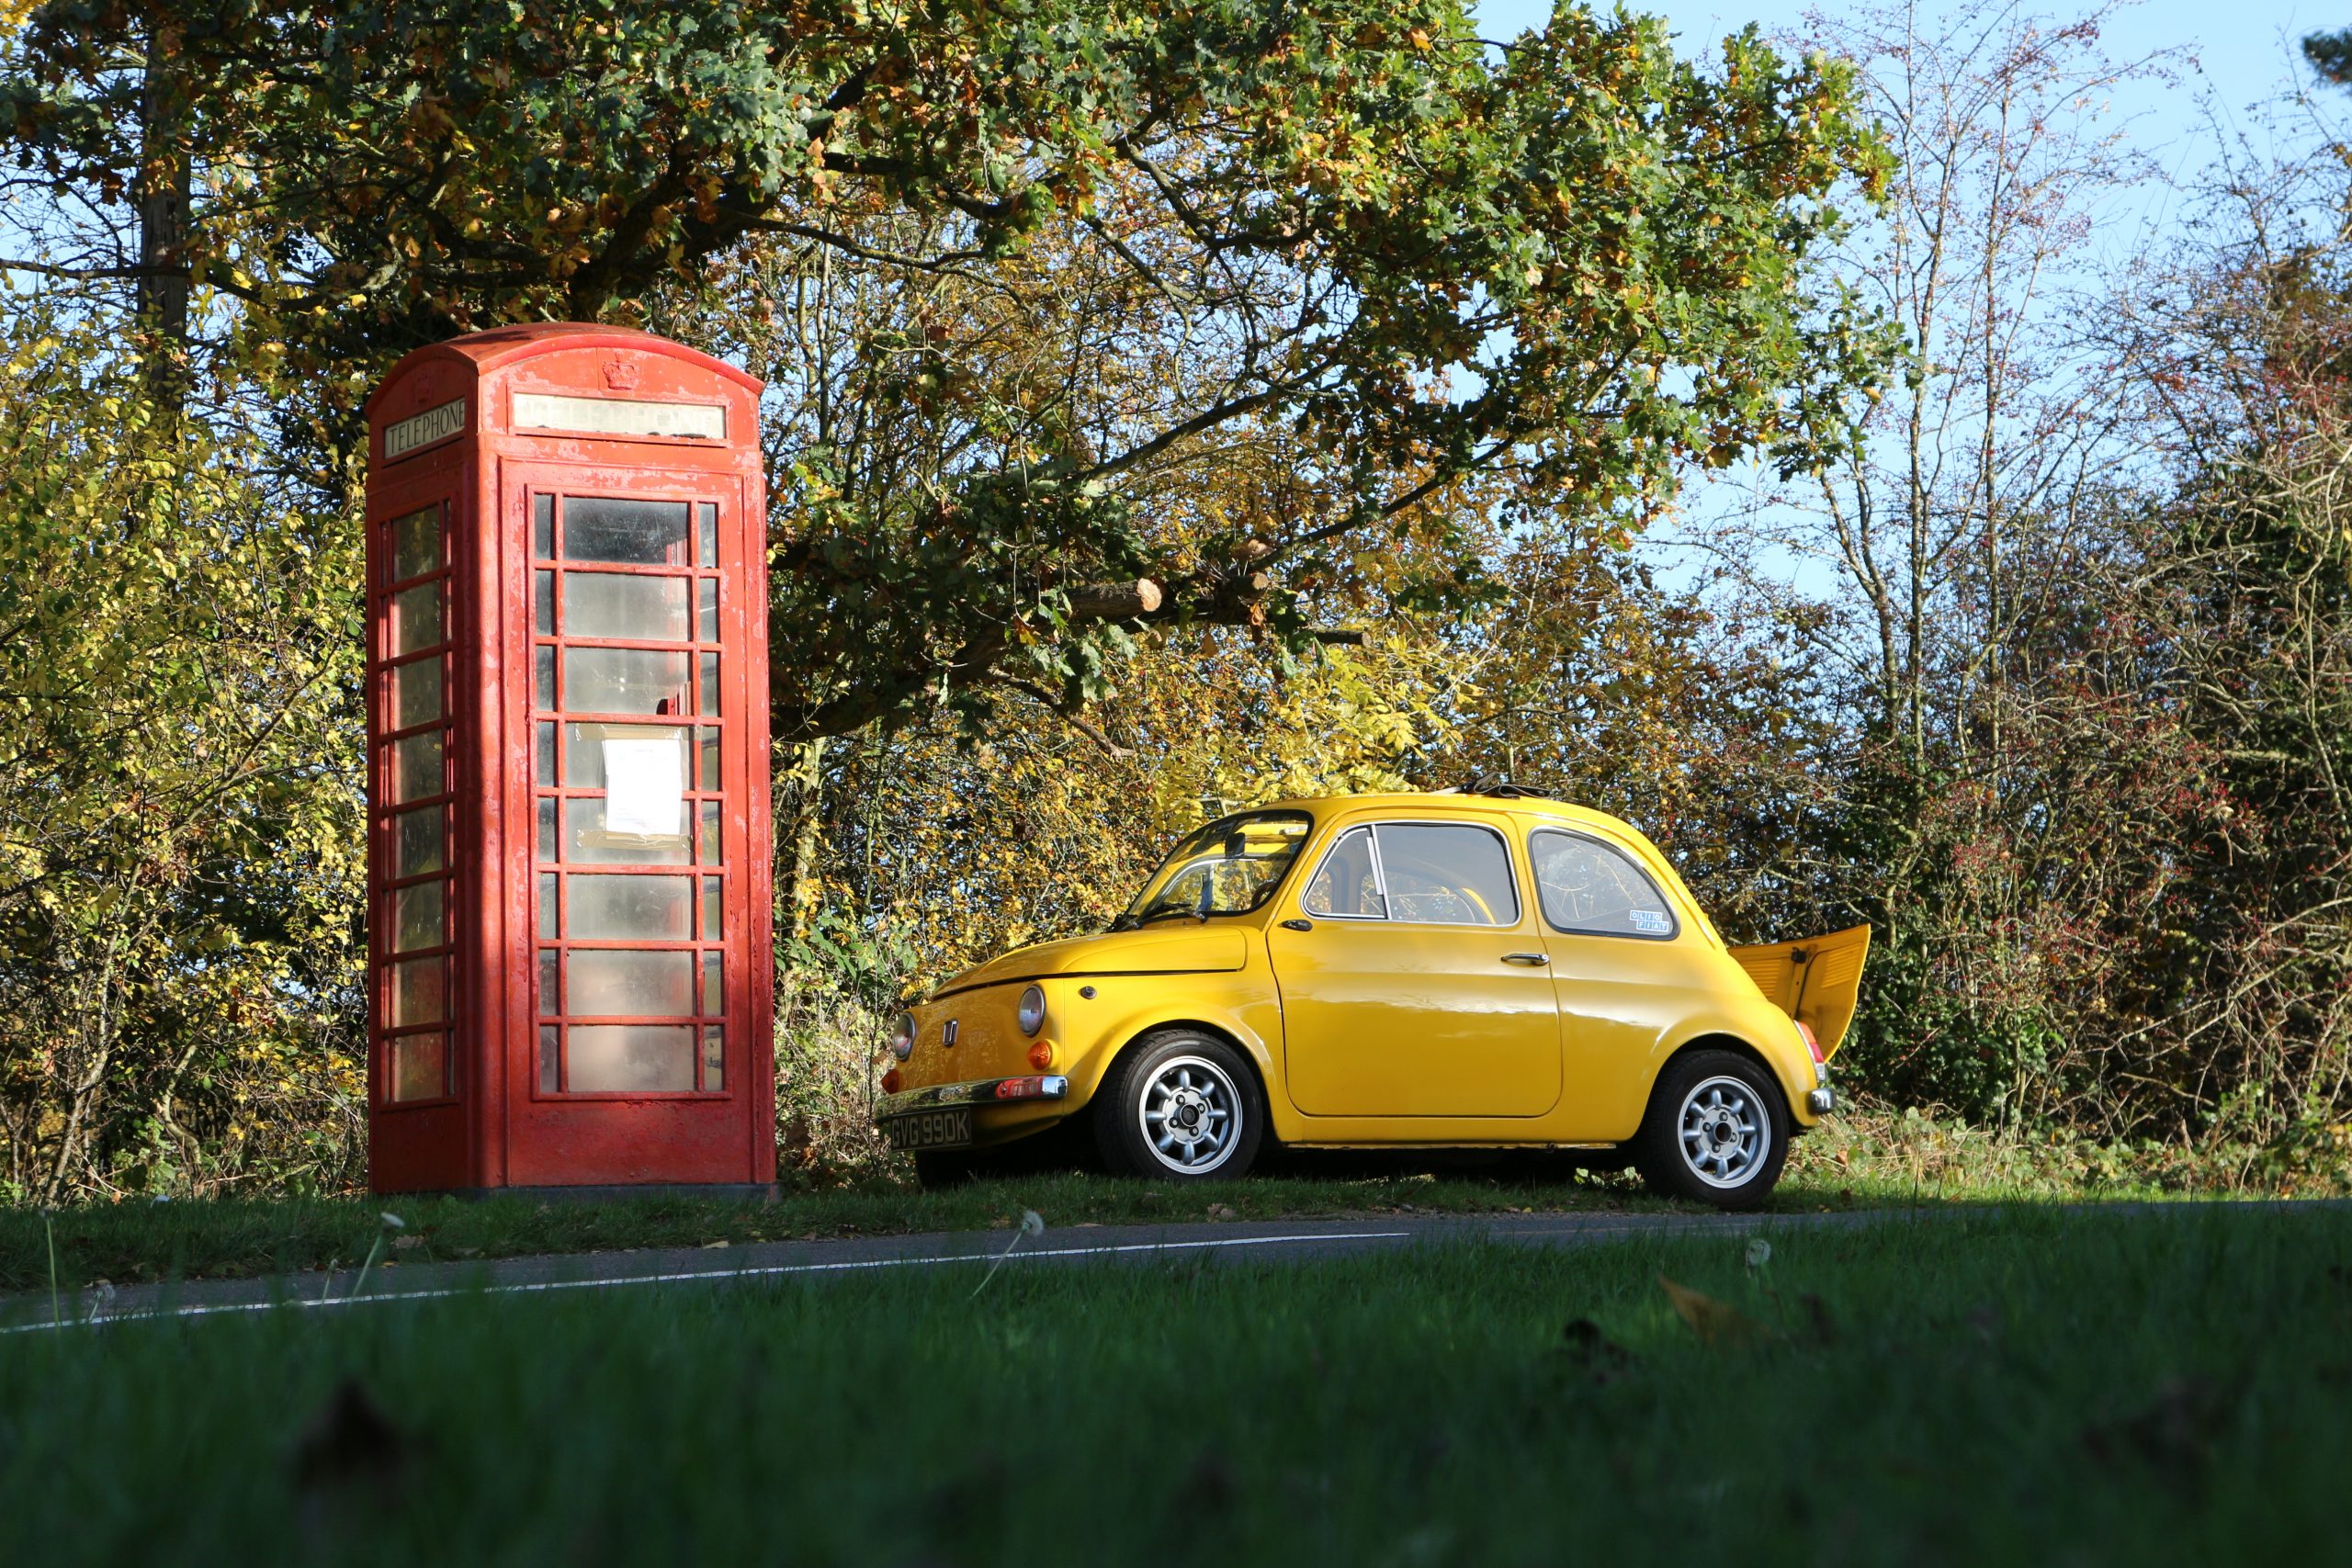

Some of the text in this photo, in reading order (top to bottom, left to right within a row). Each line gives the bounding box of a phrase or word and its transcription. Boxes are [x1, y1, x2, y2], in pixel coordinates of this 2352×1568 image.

[390, 400, 465, 454] TELEPHONE
[1632, 911, 1660, 921] OLIO
[1639, 921, 1667, 931] FIAT
[891, 1111, 969, 1147] GVG 990K
